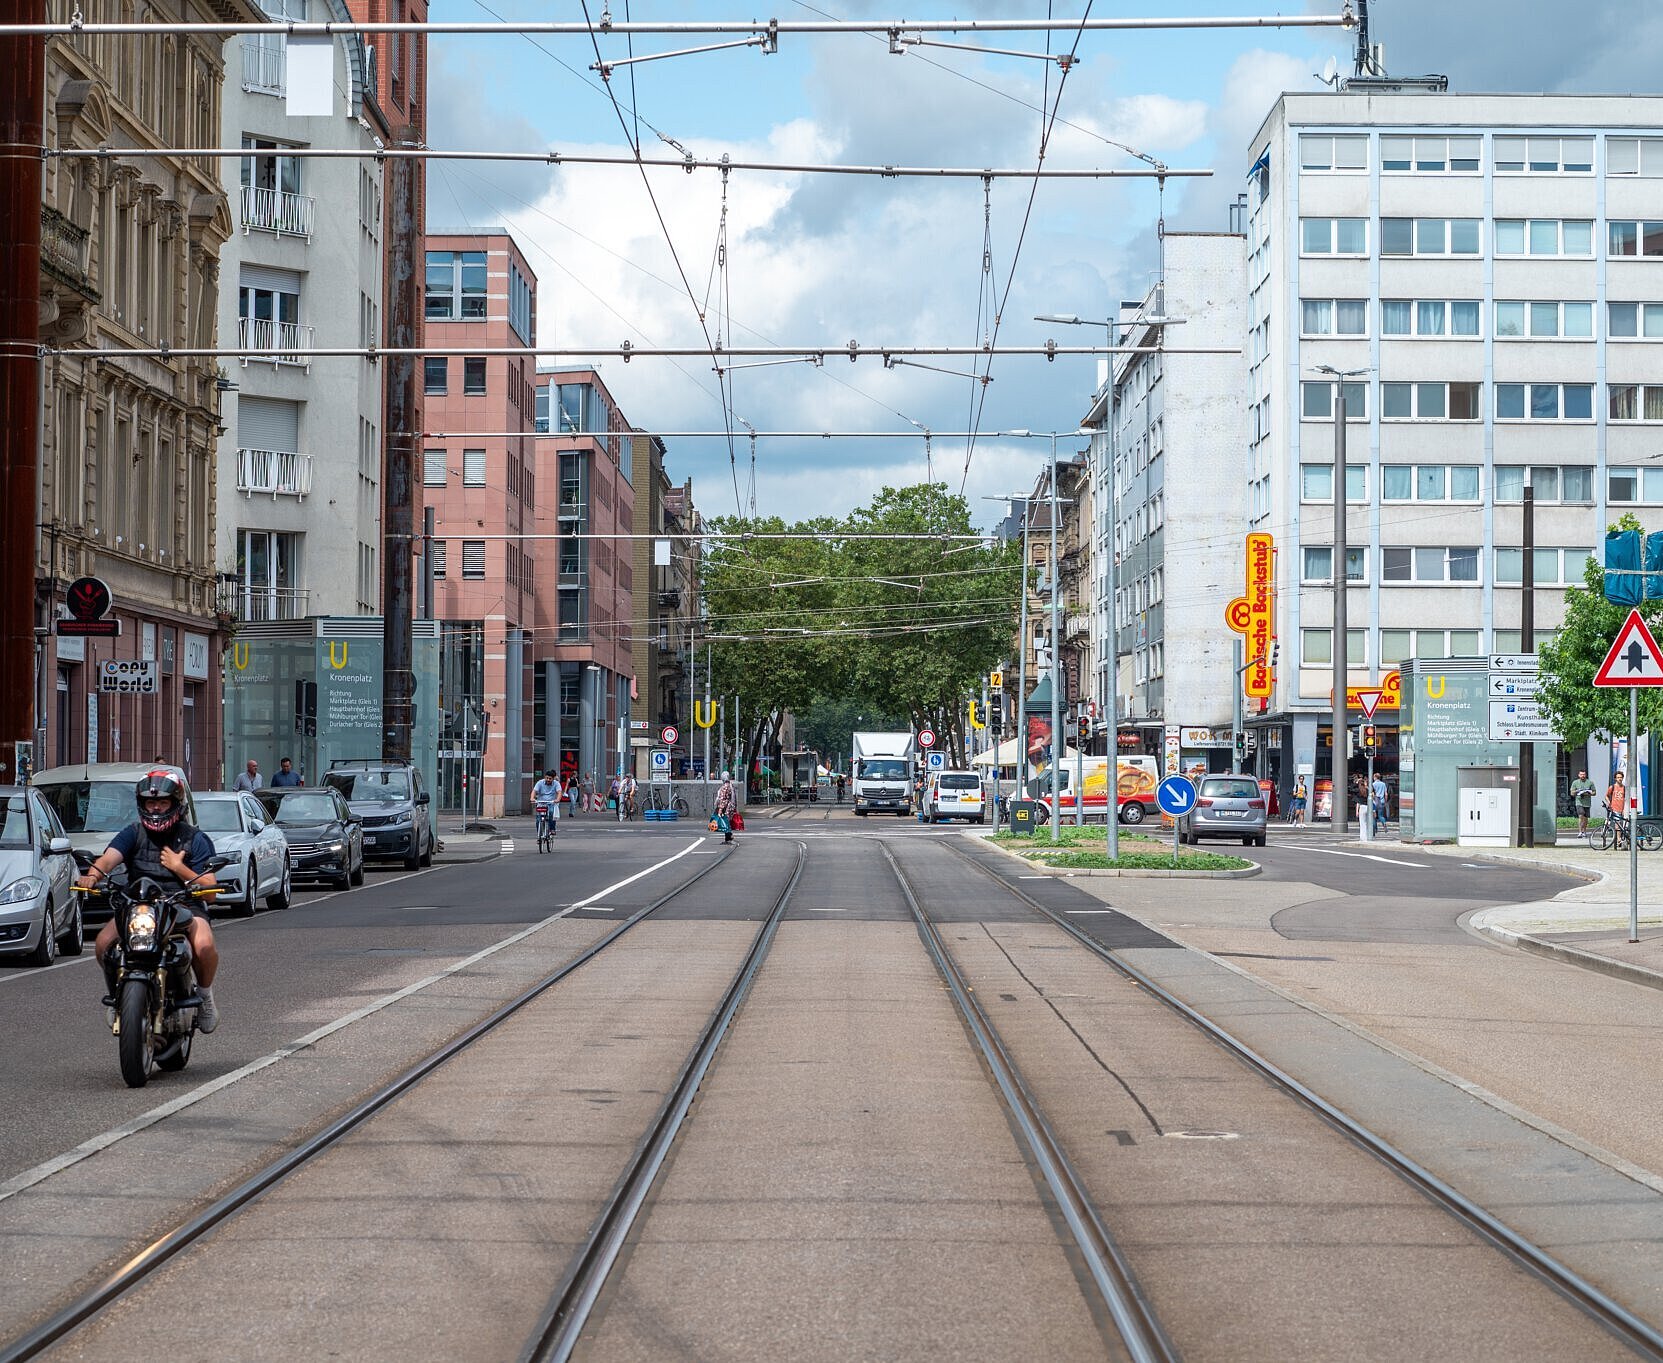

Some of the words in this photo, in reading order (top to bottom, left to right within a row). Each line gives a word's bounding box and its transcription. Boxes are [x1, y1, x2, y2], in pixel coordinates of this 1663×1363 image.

[330, 641, 347, 669] U
[1252, 618, 1267, 689] Badische
[106, 660, 148, 675] Copy
[104, 677, 152, 692] World
[330, 674, 372, 683] Kronenplatz
[994, 674, 1000, 685] 2
[1427, 676, 1445, 698] U
[695, 700, 717, 728] U
